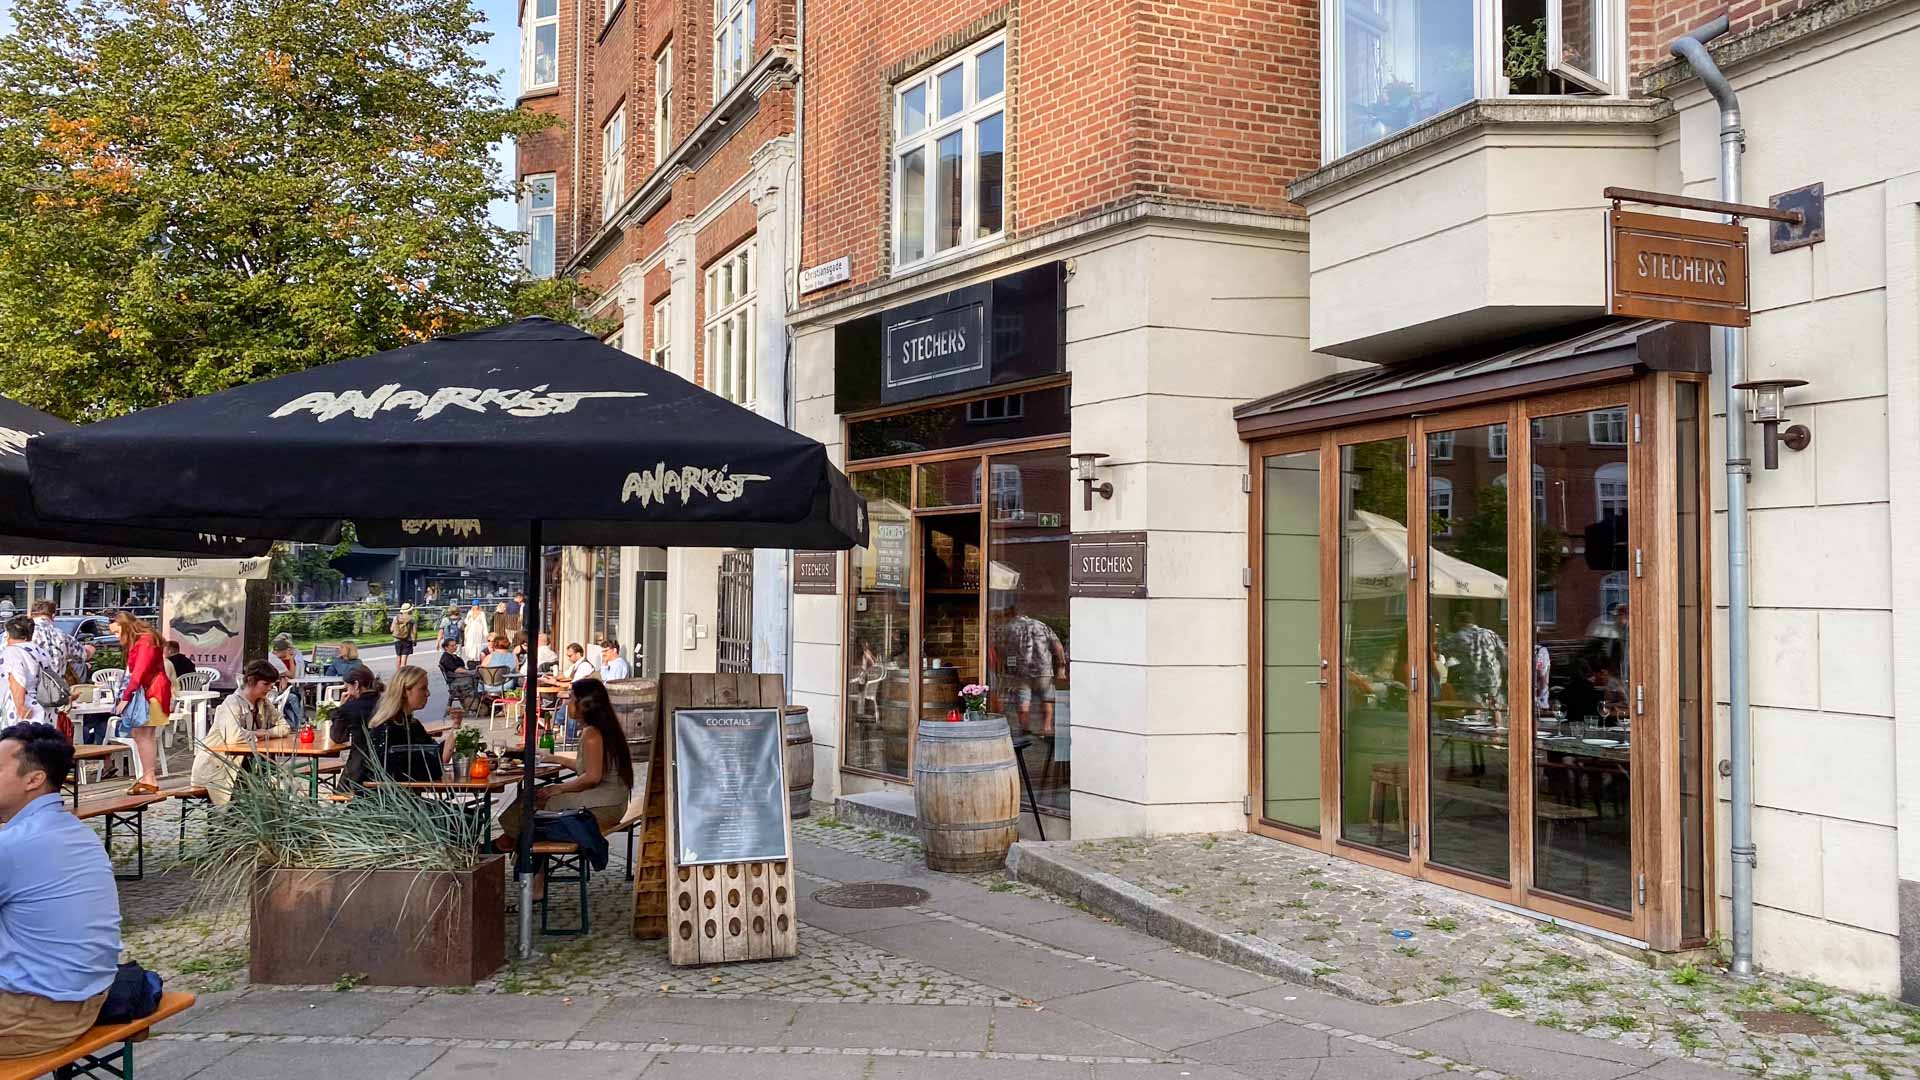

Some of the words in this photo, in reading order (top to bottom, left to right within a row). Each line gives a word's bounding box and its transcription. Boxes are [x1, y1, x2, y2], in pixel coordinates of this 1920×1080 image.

[1638, 251, 1728, 286] STECHERS
[902, 326, 966, 364] STECHERS
[239, 560, 258, 575] Jelen
[801, 563, 829, 576] STECHERS
[1082, 556, 1133, 573] STECHERS
[706, 718, 751, 726] COCKTAILS
